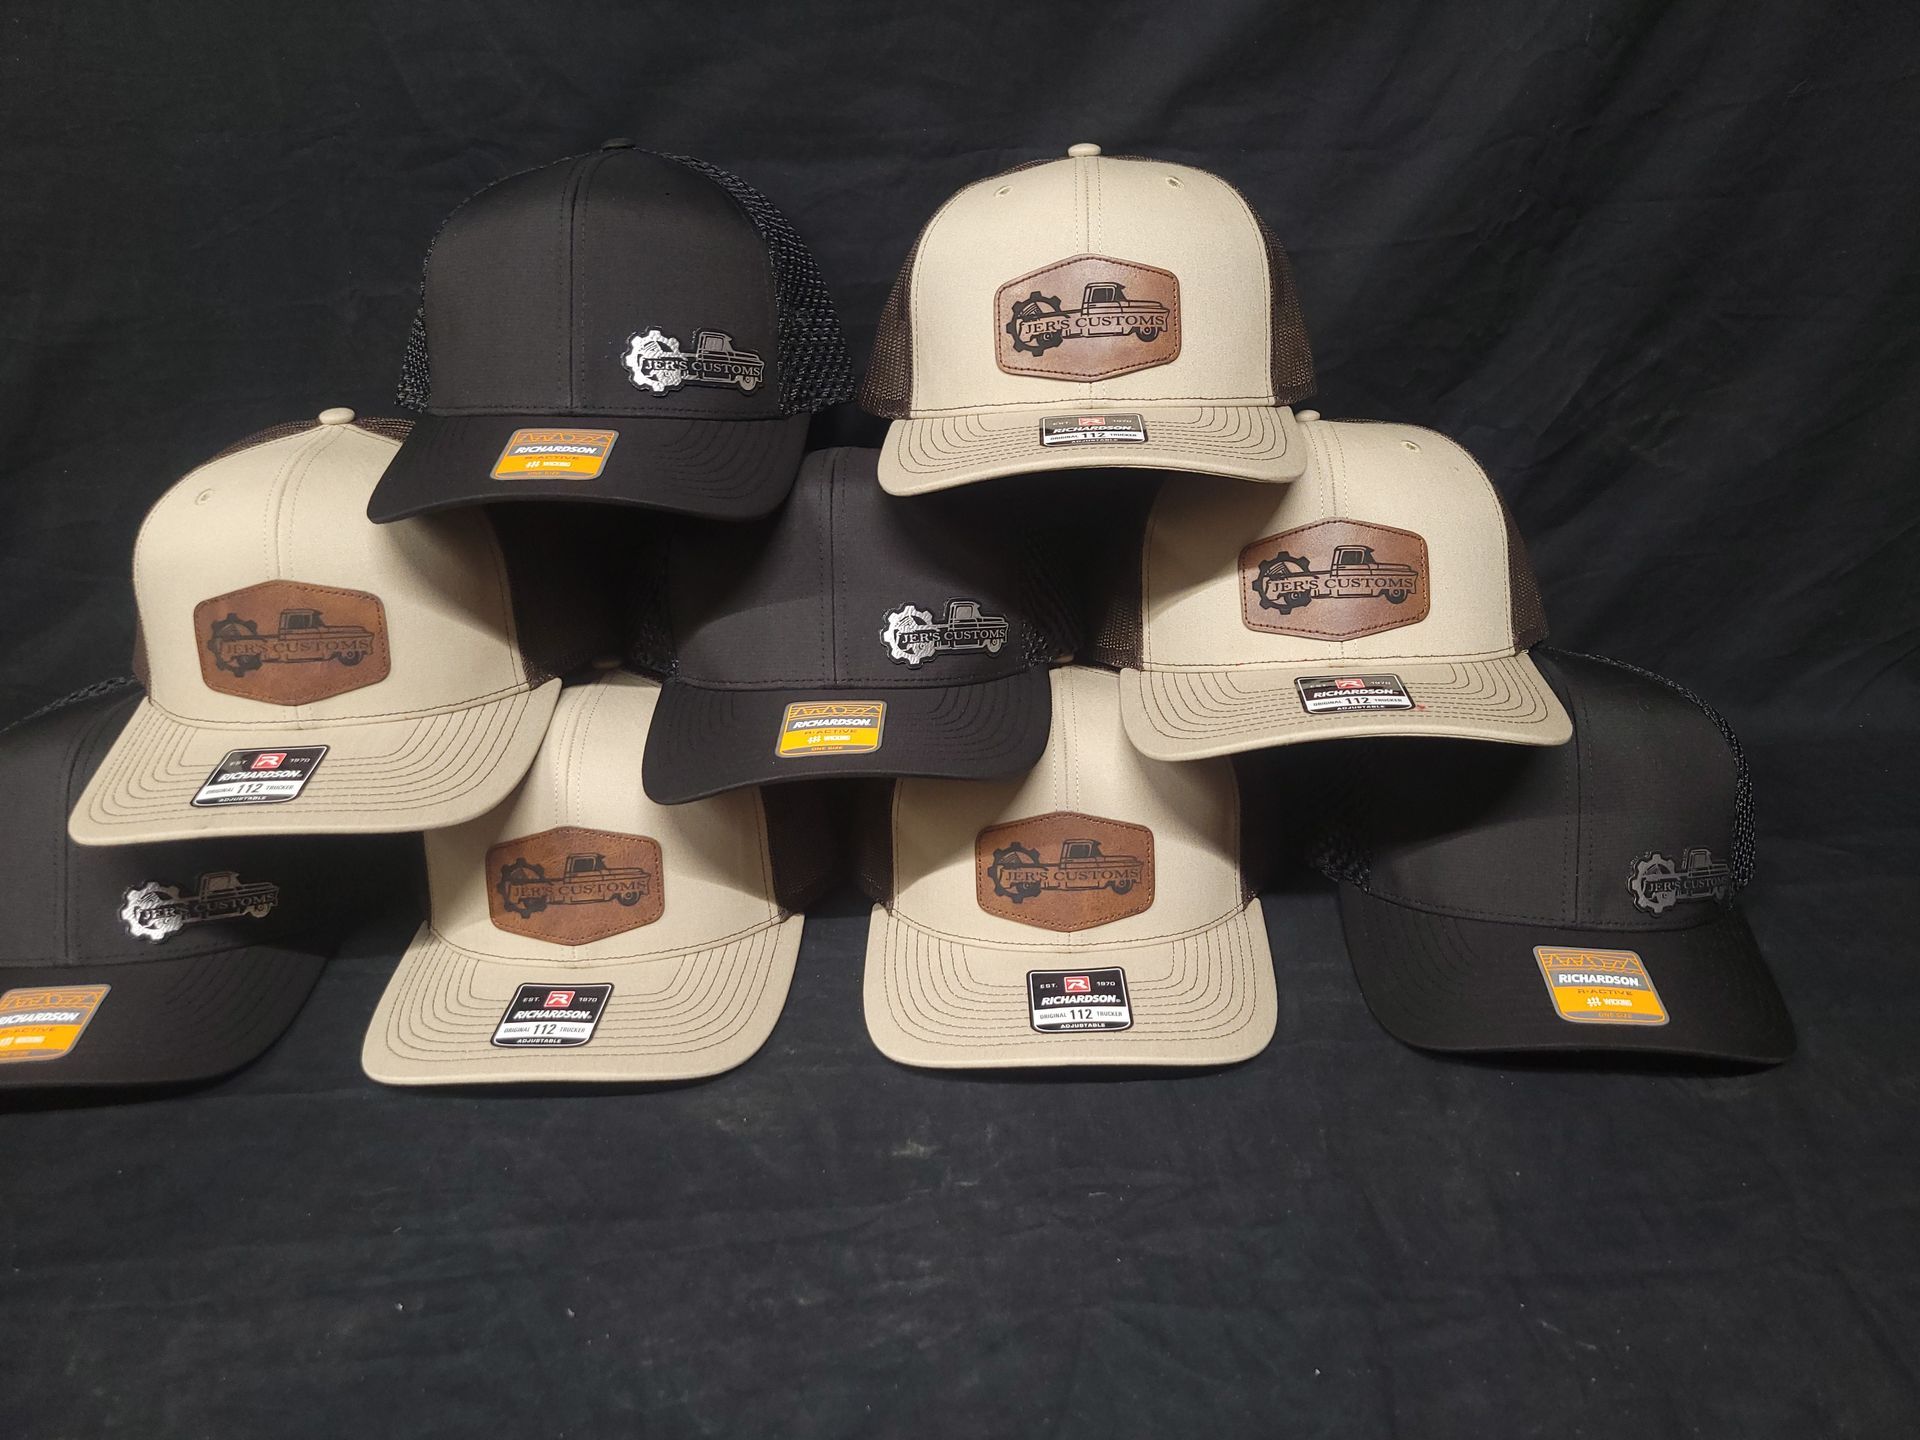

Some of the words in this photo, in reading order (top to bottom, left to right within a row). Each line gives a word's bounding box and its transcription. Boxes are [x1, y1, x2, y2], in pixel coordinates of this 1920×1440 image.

[1025, 317, 1070, 334] JER'S
[1075, 315, 1165, 328] CUSTOMS
[644, 359, 688, 371] JER'S
[691, 361, 761, 376] CUSTOMS
[1053, 425, 1132, 434] RICHARDSON
[514, 445, 597, 454] RICHARDSON
[1272, 579, 1319, 593] JER'S
[1324, 577, 1414, 589] CUSTOMS
[901, 632, 940, 644] JER'S
[944, 629, 1005, 641] CUSTOMS
[272, 639, 370, 653] CUSTOMS
[1313, 689, 1395, 698] RICHARDSON
[793, 718, 871, 729] RICHARDSON
[218, 769, 302, 782] RICHARDSON
[236, 783, 264, 794] 112
[1006, 870, 1048, 882] JER'S
[1053, 868, 1139, 881] CUSTOMS
[558, 880, 648, 896] CUSTOMS
[194, 892, 277, 912] CUSTOMS
[1559, 973, 1639, 986] RICHARDSON
[1041, 994, 1117, 1006] RICHARDSON
[513, 1009, 592, 1020] RICHARDSON
[1070, 1008, 1093, 1020] 112
[533, 1023, 557, 1035] 112
